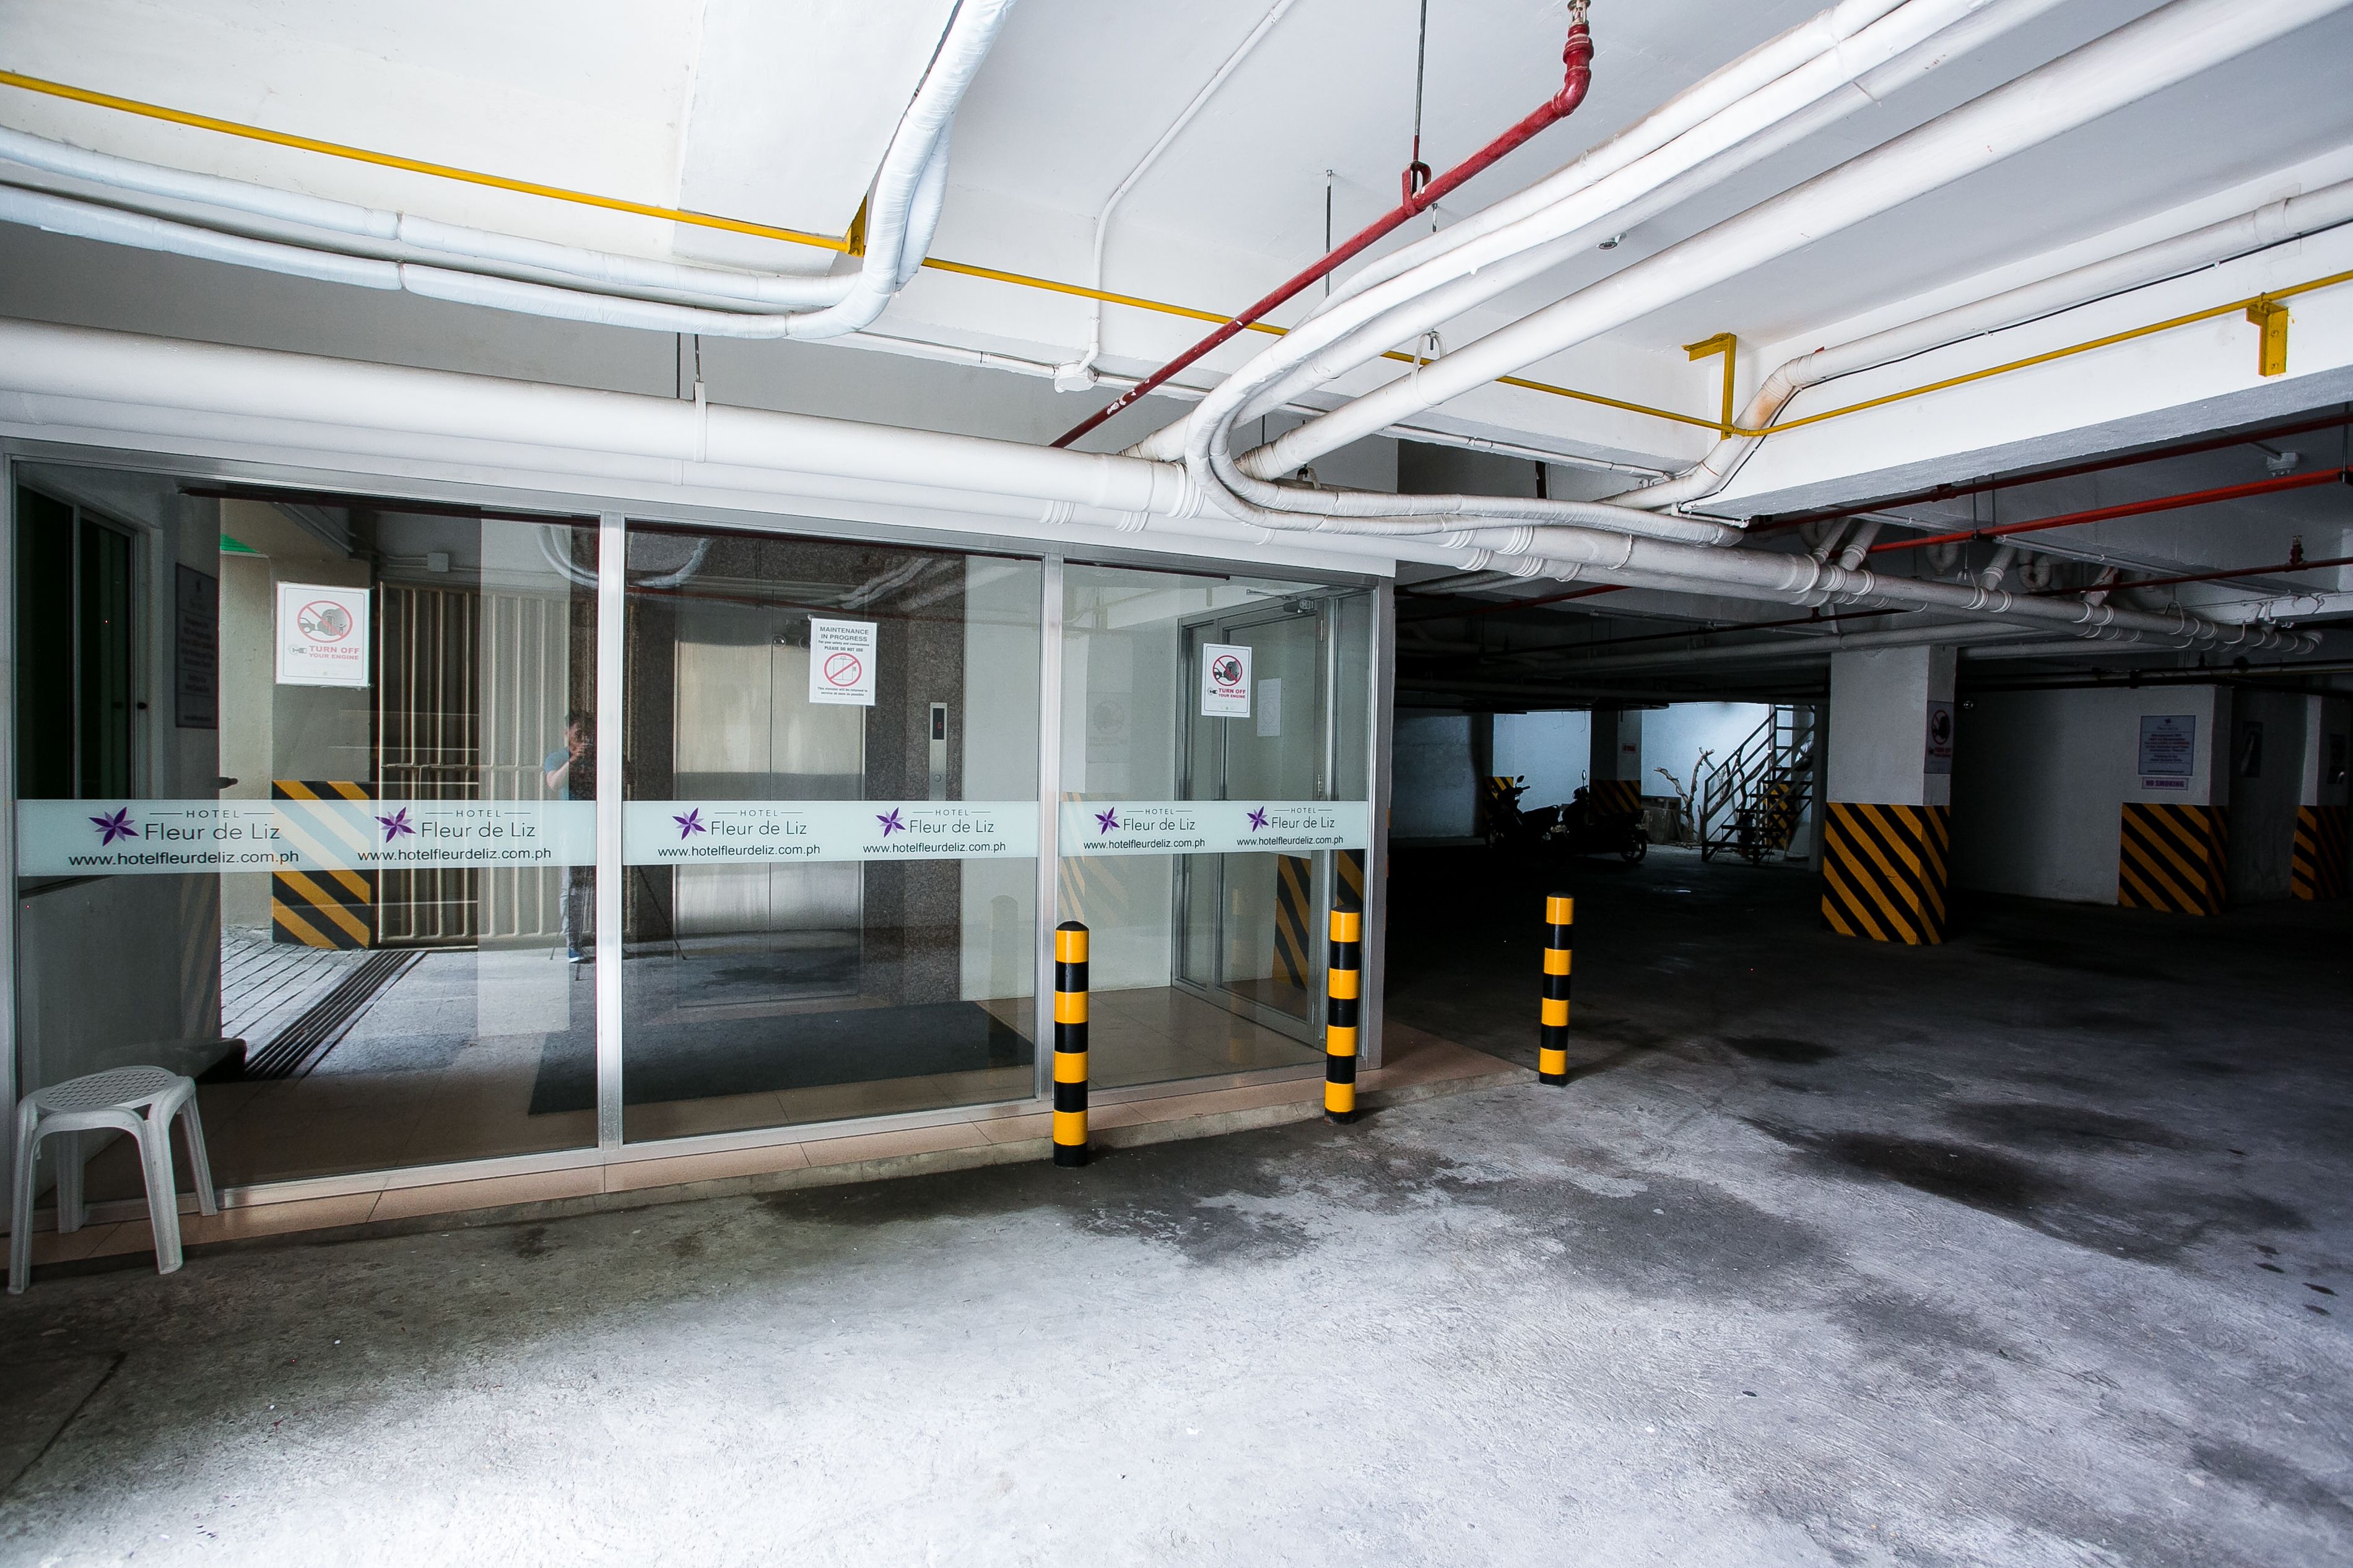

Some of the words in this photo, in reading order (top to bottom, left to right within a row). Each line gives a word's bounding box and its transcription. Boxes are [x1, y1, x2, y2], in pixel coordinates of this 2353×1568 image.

[819, 626, 869, 635] MAINTENANCE
[711, 821, 754, 836] Fleur
[759, 820, 780, 835] de
[787, 821, 807, 834] Liz
[910, 820, 947, 833] Fleur
[952, 819, 970, 833] de
[976, 820, 994, 833] Liz
[1123, 818, 1155, 831] Fleur
[1159, 817, 1175, 831] de
[1180, 818, 1196, 830] Liz
[1271, 816, 1300, 829] Fleur
[1303, 816, 1317, 828] de
[1321, 816, 1335, 828] Liz
[145, 823, 206, 840] Fleur
[213, 822, 242, 839] de
[252, 823, 281, 839] Liz
[422, 822, 472, 838] Fleur
[479, 821, 503, 838] de
[511, 822, 536, 837] Liz
[1083, 838, 1205, 849] www.hotelfleurdeliz.com.ph
[1237, 836, 1344, 846] www.hotelfleurdeliz.com.ph
[357, 848, 551, 861] www.hotelfleurdeliz.com.ph
[658, 844, 820, 857] www.hotelfleurdeliz.com.ph
[863, 842, 1006, 854] www.hotelfleurdeliz.com.ph
[68, 851, 299, 865] www.hotelfleurdeliz.com.ph
